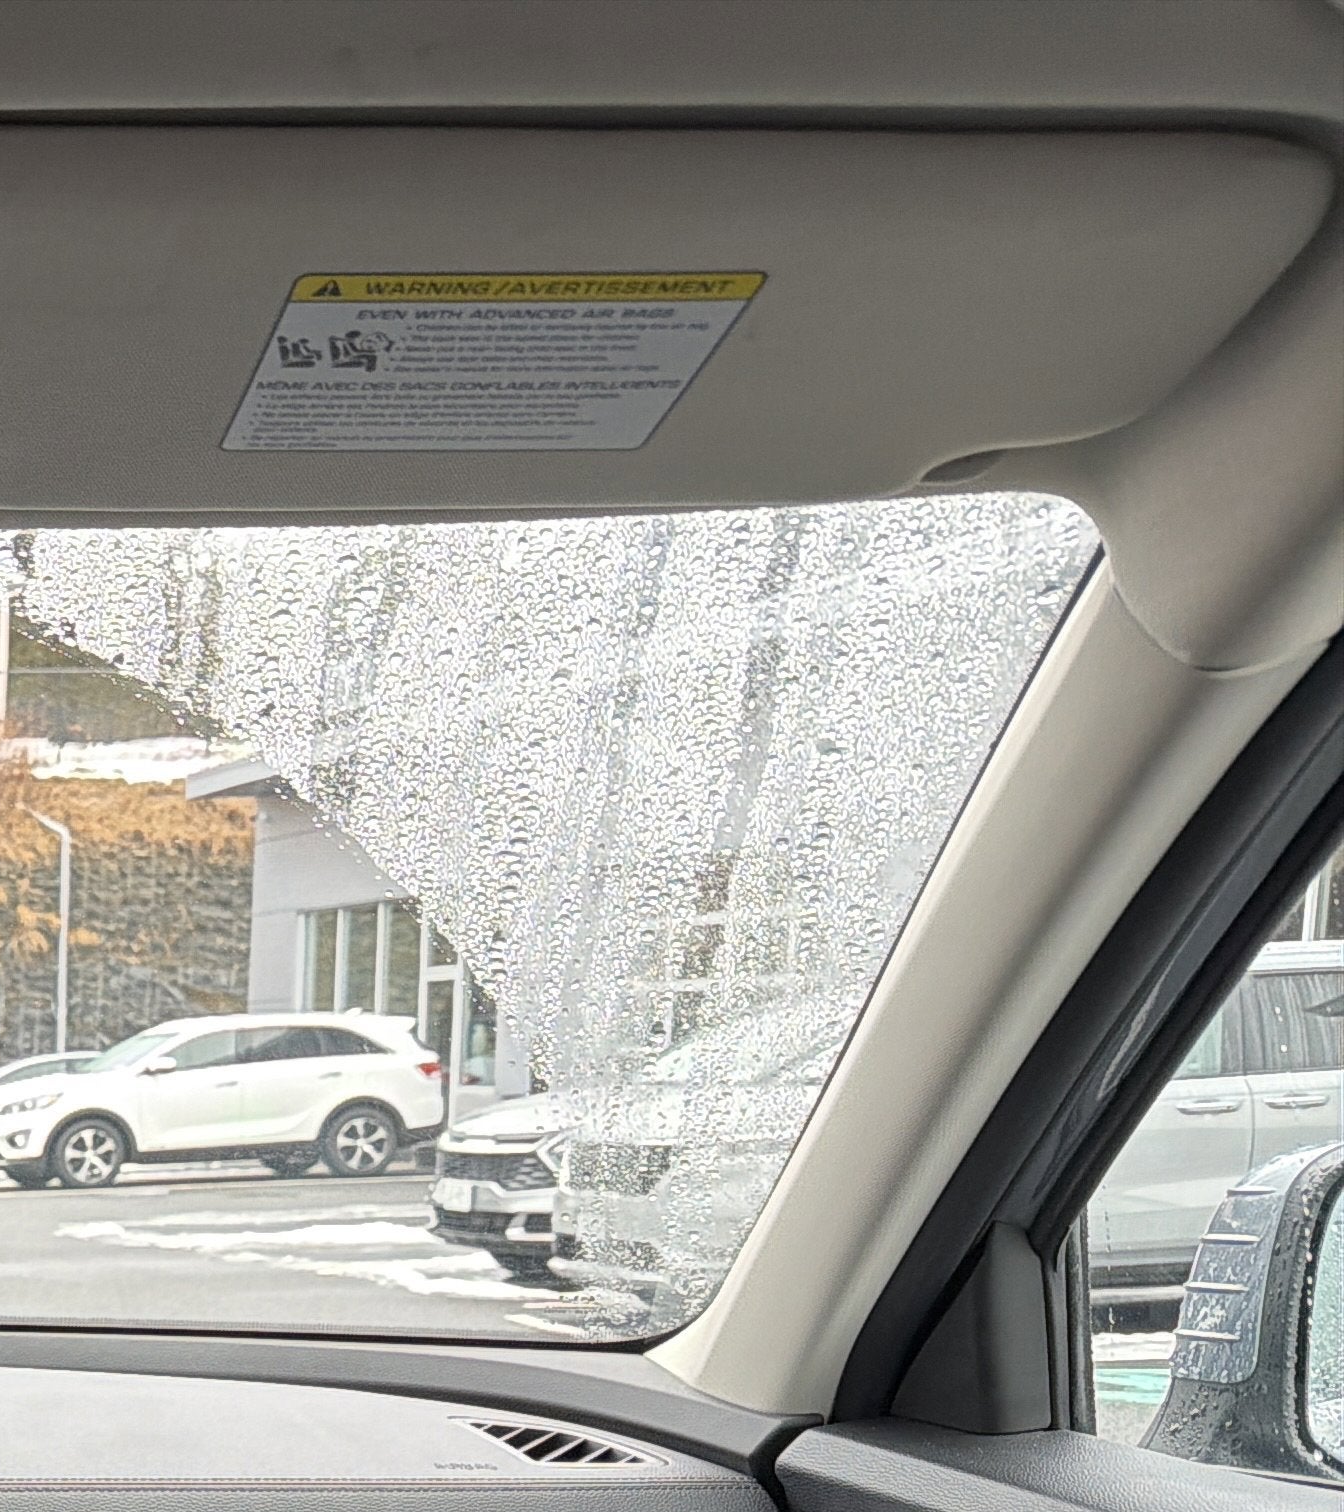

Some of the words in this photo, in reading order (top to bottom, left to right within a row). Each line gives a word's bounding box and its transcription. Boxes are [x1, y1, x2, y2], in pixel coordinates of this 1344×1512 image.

[365, 281, 490, 295] WARNING
[355, 309, 409, 320] EVEN
[414, 309, 464, 320] WITH
[468, 308, 577, 320] ADVANCED
